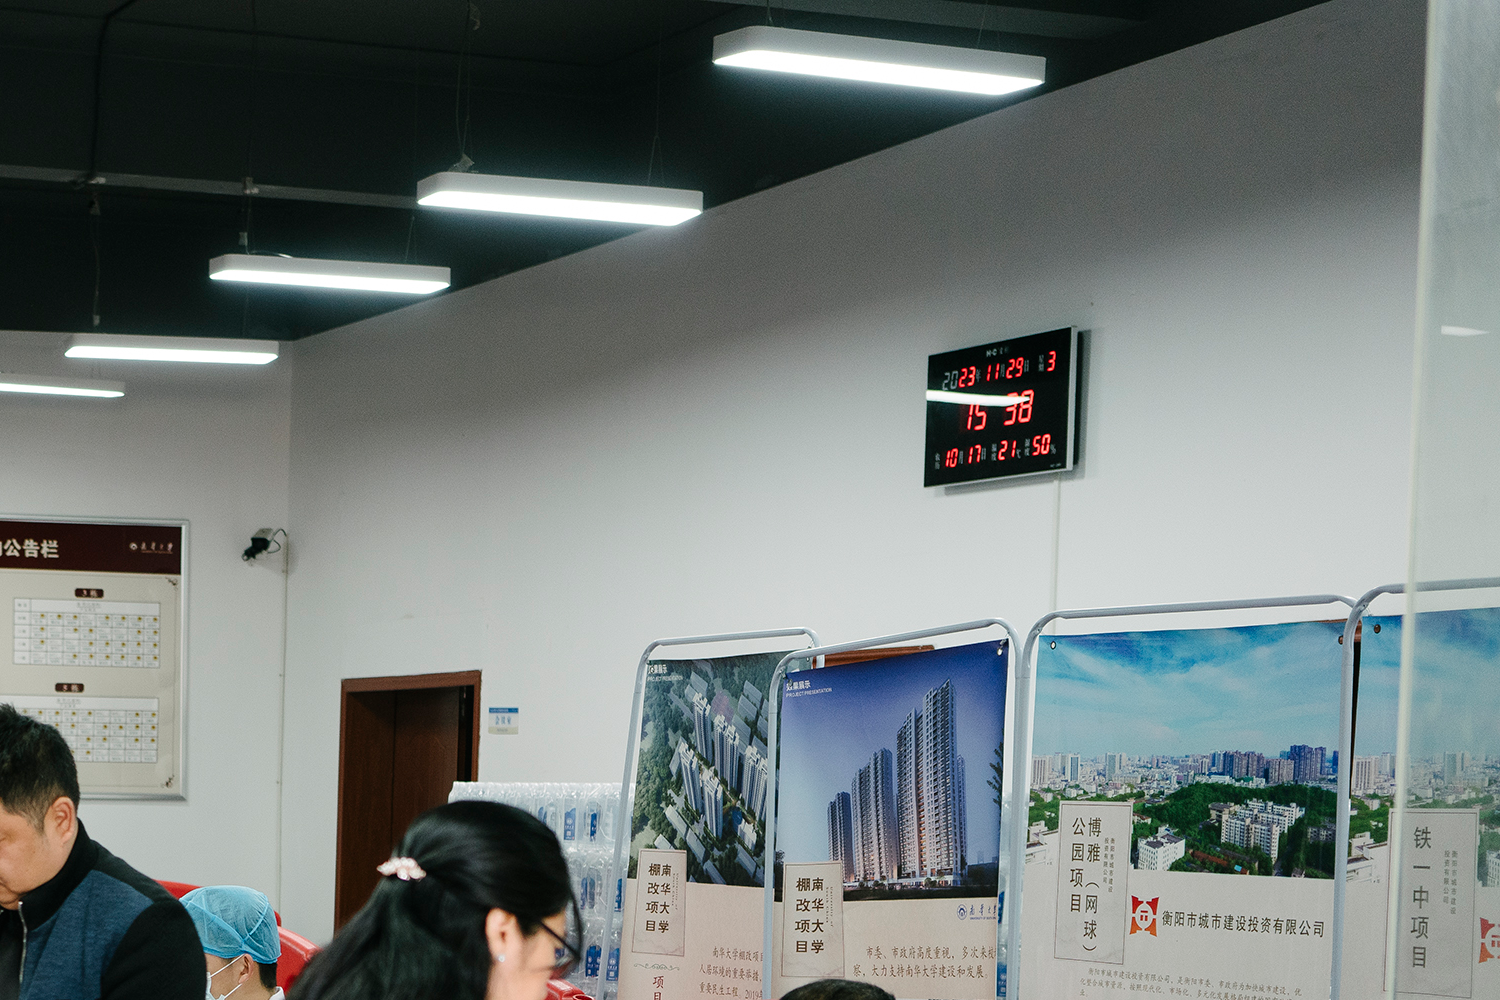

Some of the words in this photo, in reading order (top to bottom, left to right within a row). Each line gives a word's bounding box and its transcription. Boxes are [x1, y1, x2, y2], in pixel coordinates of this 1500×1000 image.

[967, 402, 987, 430] 15
[646, 863, 661, 932] 棚改项目
[658, 865, 672, 934] 南华大学
[1069, 817, 1085, 913] 公园项目
[1411, 826, 1432, 969] 铁一中项目
[794, 877, 810, 953] 棚改项目
[811, 877, 825, 954] 南华大学
[1161, 910, 1325, 938] 衡阳市城市建设投资有限公司
[866, 946, 997, 960] 市委、市政府高度重视，多次来校
